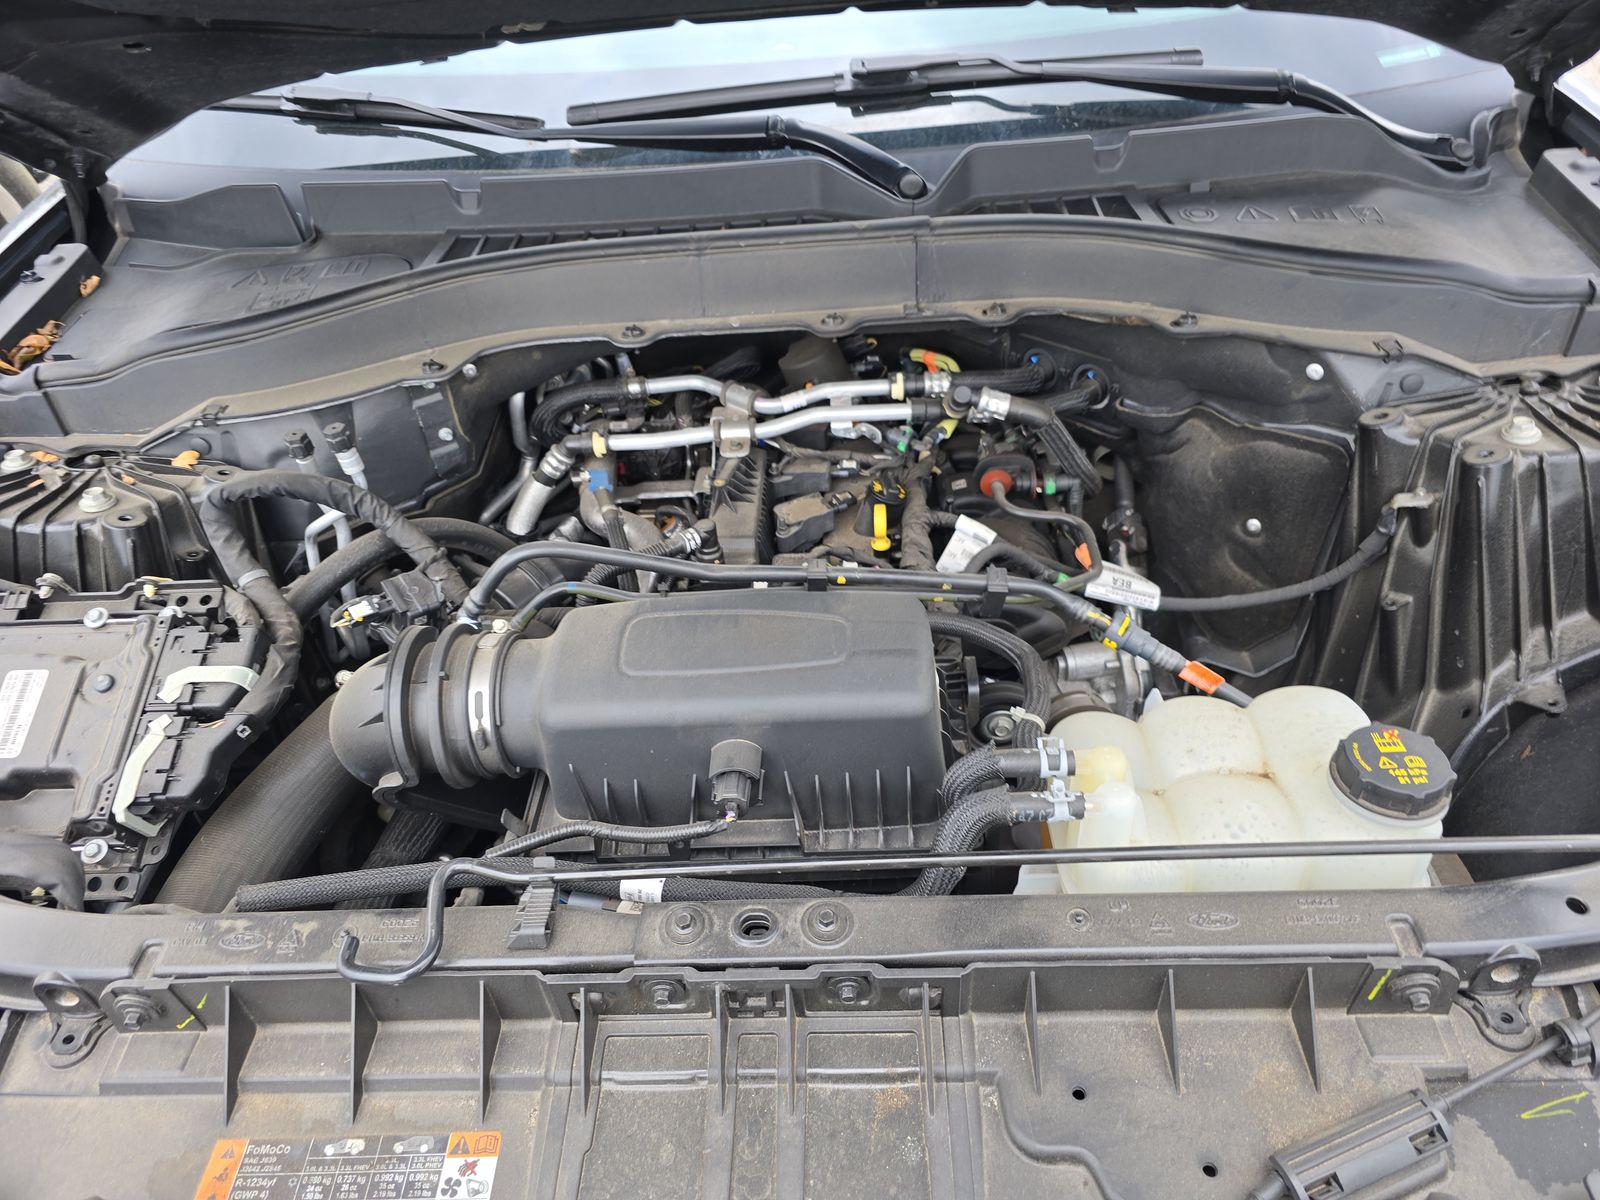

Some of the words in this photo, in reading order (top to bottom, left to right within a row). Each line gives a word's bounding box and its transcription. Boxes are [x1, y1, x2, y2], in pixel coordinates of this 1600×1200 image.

[246, 1143, 291, 1155] FoMoCo
[337, 1174, 357, 1184] 0.737
[357, 1174, 367, 1185] kg
[374, 1173, 394, 1182] 0.992
[394, 1172, 404, 1183] kg
[409, 1172, 429, 1182] 0.992
[429, 1173, 439, 1182] kg
[230, 1190, 259, 1200] (GWP
